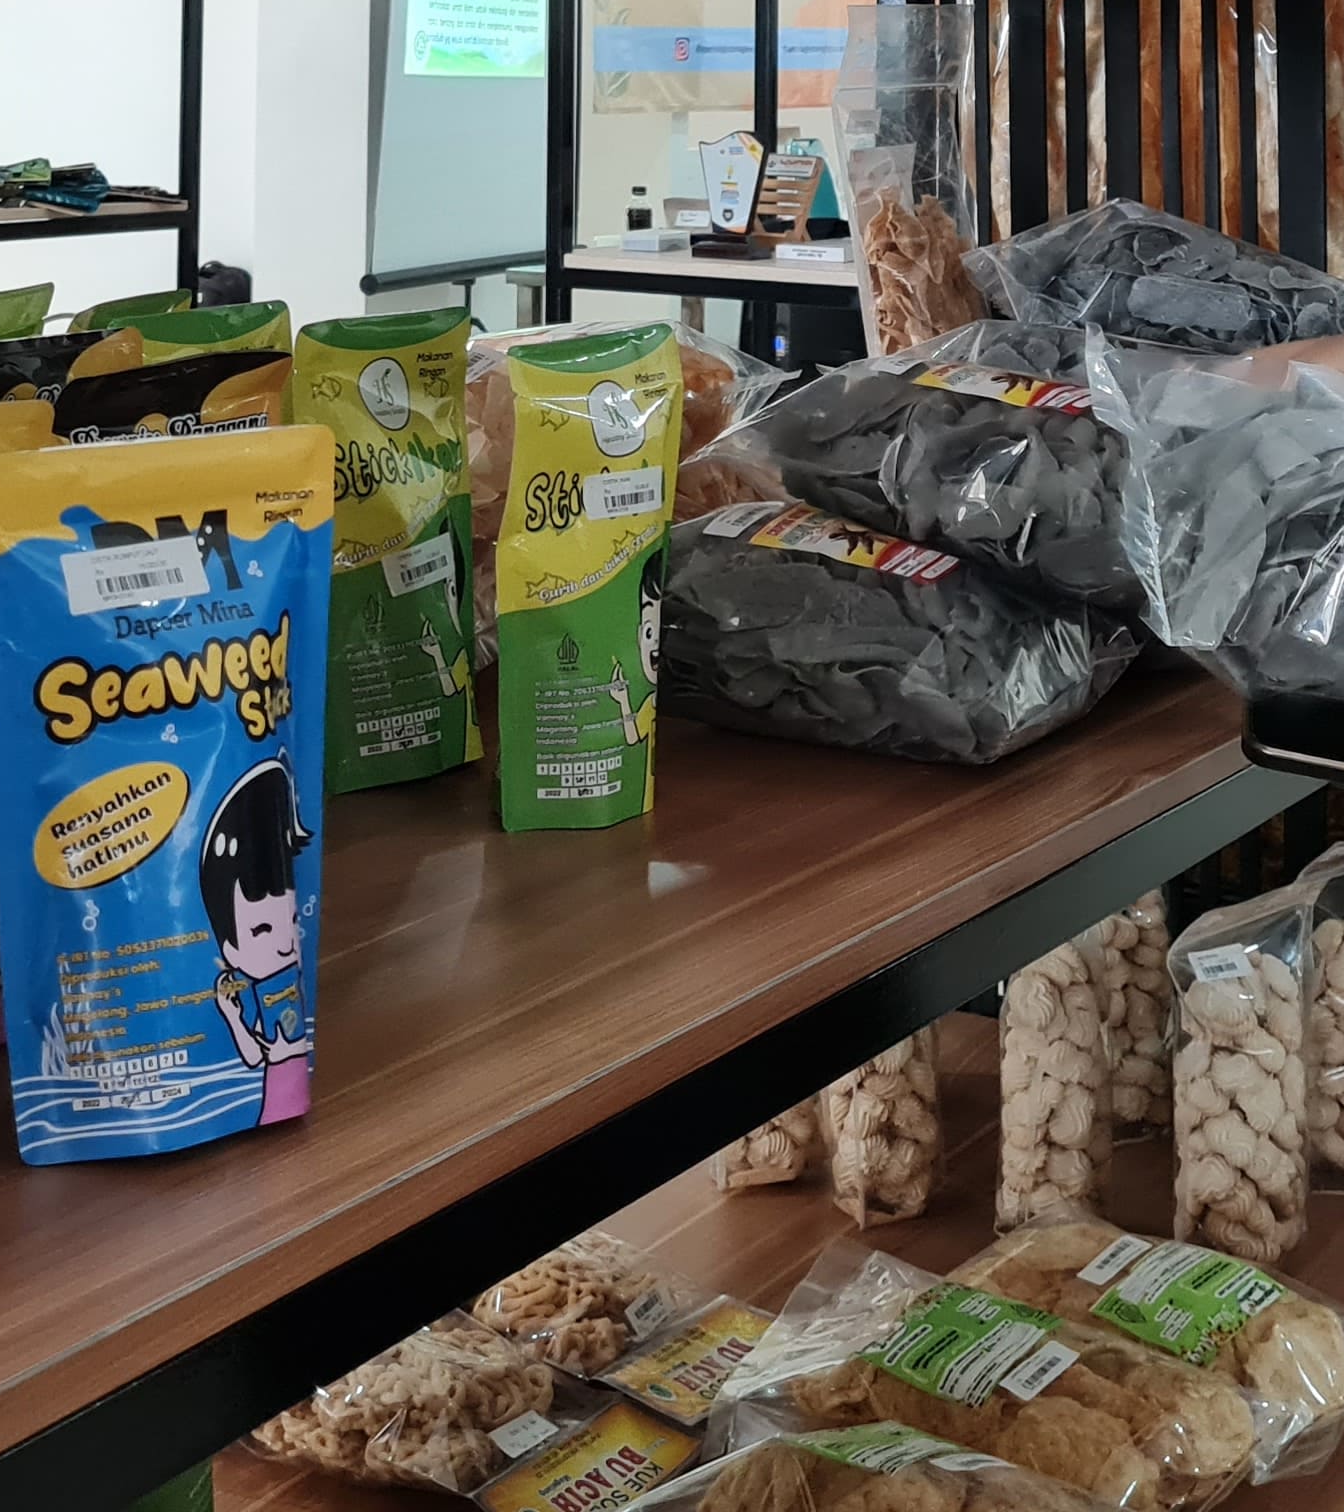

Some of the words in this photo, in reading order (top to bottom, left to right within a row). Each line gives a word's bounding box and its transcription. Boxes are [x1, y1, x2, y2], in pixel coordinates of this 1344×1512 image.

[416, 352, 454, 364] Makanan
[419, 367, 446, 381] Ringan
[334, 438, 413, 502] Stick
[256, 489, 314, 504] Makanan
[525, 466, 587, 532] Sti
[538, 579, 579, 604] Gurih
[581, 570, 604, 589] dan
[114, 611, 193, 640] Dapoer
[196, 599, 255, 624] Mina
[35, 610, 291, 745] Seaweed
[50, 771, 172, 839] Renyahkan
[61, 806, 152, 860] suasana
[67, 831, 150, 879] hatimu
[606, 1445, 648, 1478] BU
[622, 1462, 664, 1492] KUE
[551, 1467, 614, 1512] ACIH
